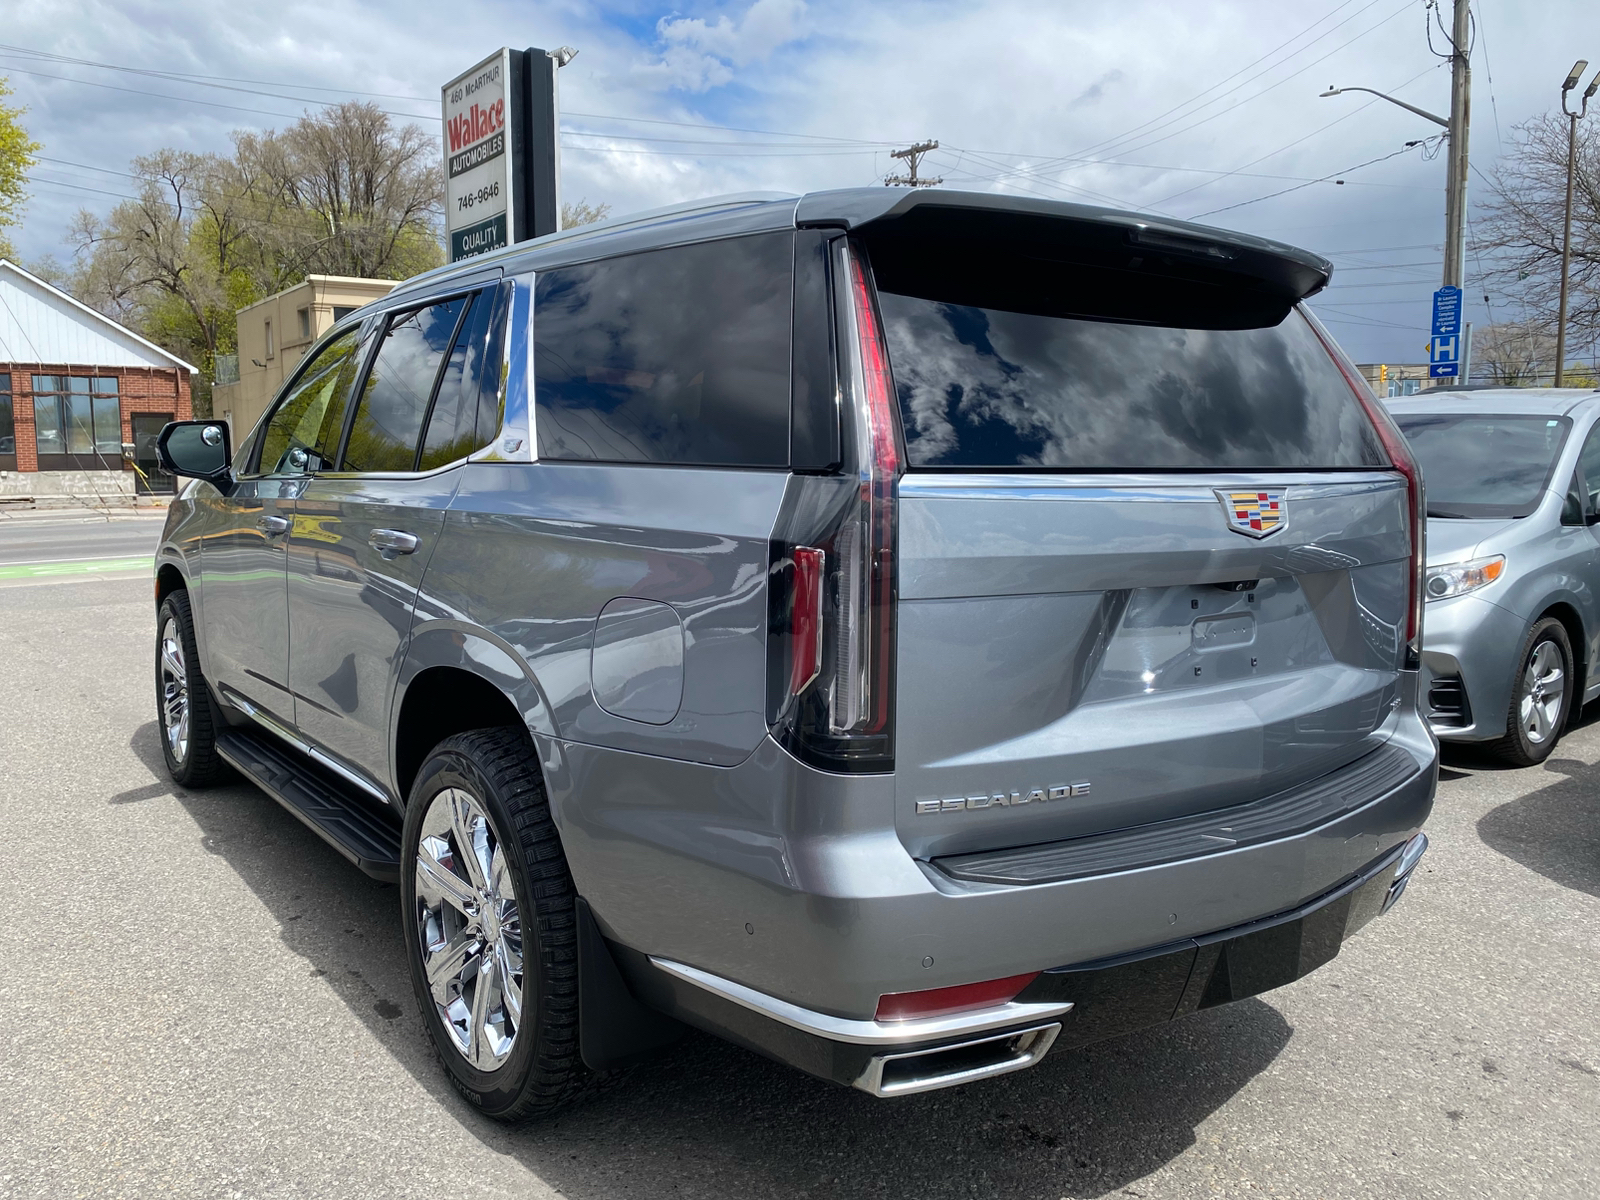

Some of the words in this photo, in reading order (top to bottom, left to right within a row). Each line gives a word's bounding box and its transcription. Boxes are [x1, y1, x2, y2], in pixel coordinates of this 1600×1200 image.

[451, 88, 463, 105] 460
[465, 65, 500, 97] McARTHUR
[447, 97, 505, 153] Wallace
[452, 135, 503, 173] AUTOMOBILES
[457, 181, 499, 212] 746-9646
[462, 224, 498, 251] QUALITY
[1434, 336, 1456, 362] H
[915, 781, 1091, 815] ESCALADE
